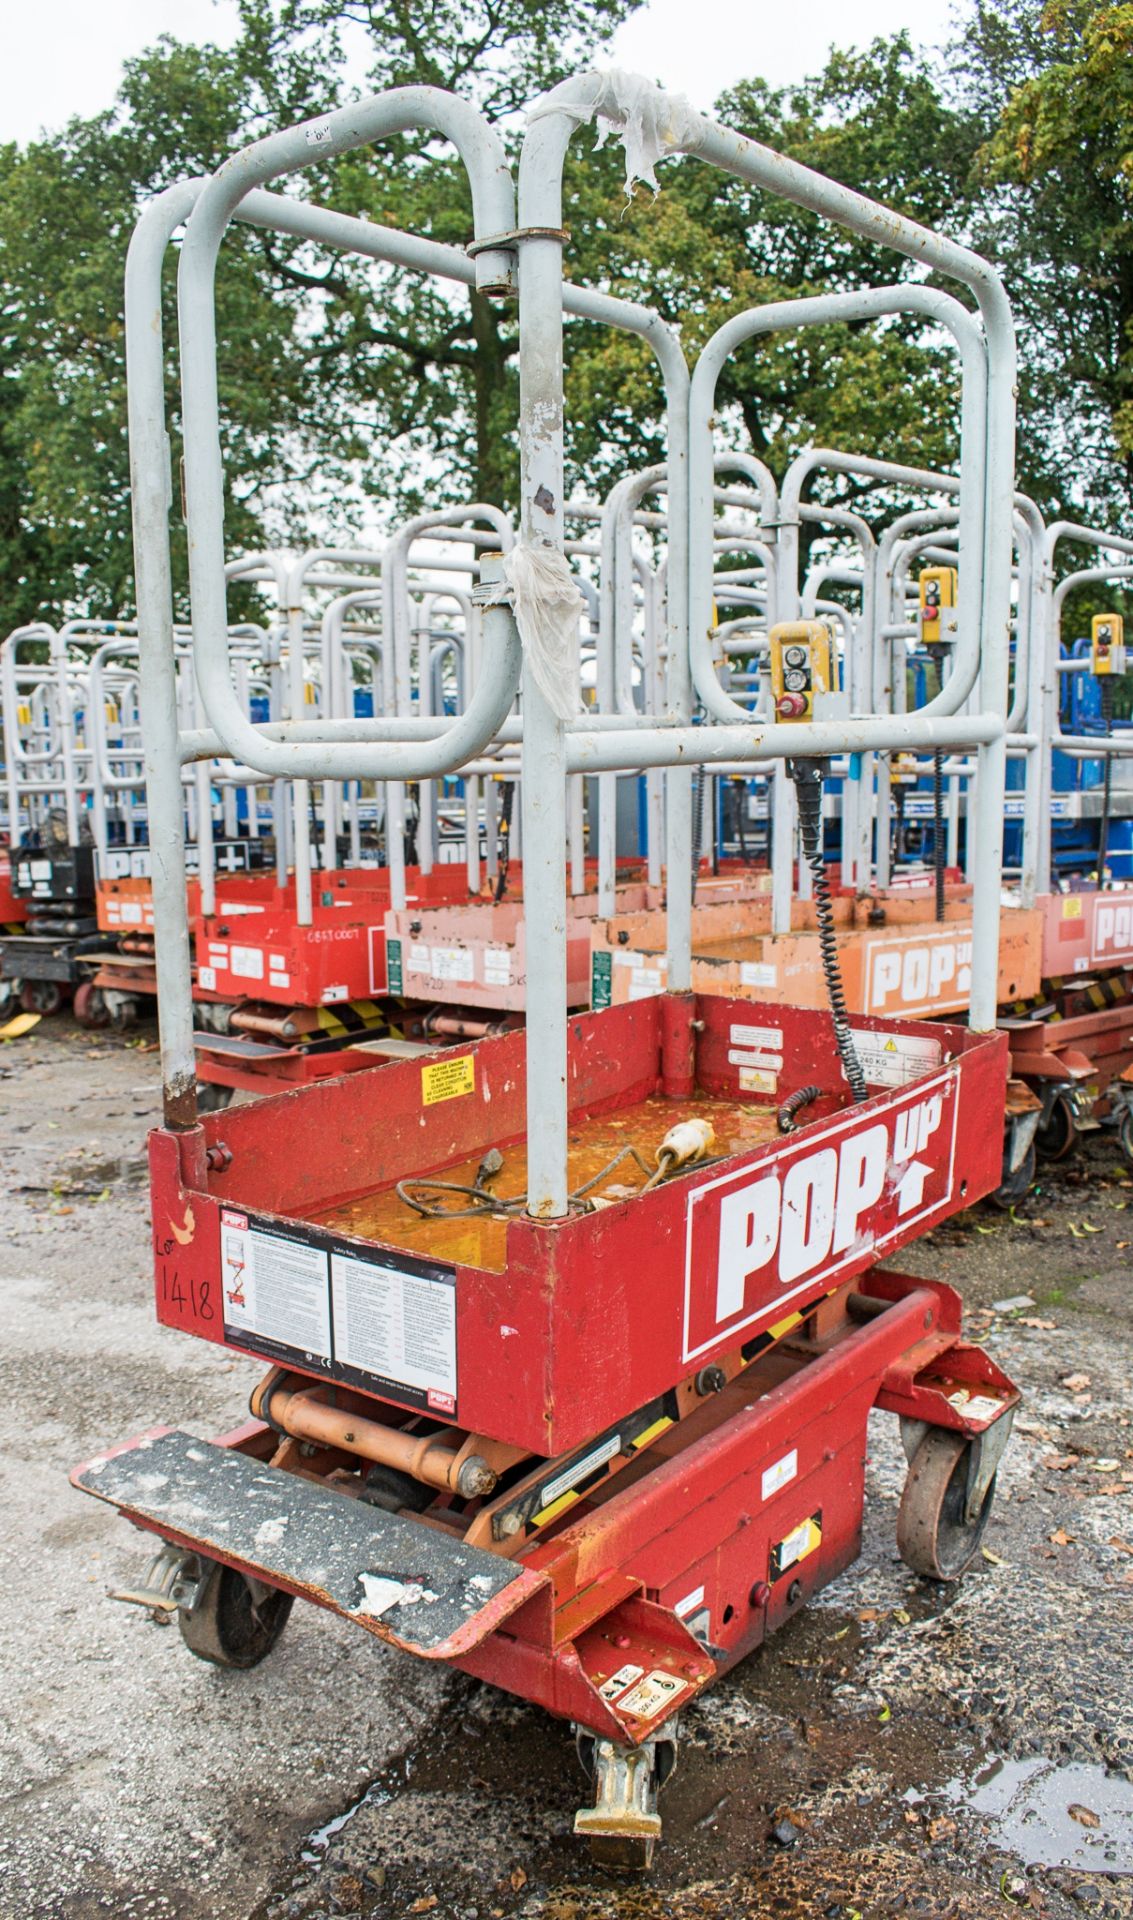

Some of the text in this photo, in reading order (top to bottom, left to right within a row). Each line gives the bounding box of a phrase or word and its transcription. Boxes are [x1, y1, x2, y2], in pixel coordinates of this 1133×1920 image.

[1097, 907, 1133, 950] PO
[872, 944, 956, 1008] POP
[860, 1056, 874, 1064] 240
[716, 1096, 943, 1323] POP UP
[163, 1265, 214, 1320] 1418
